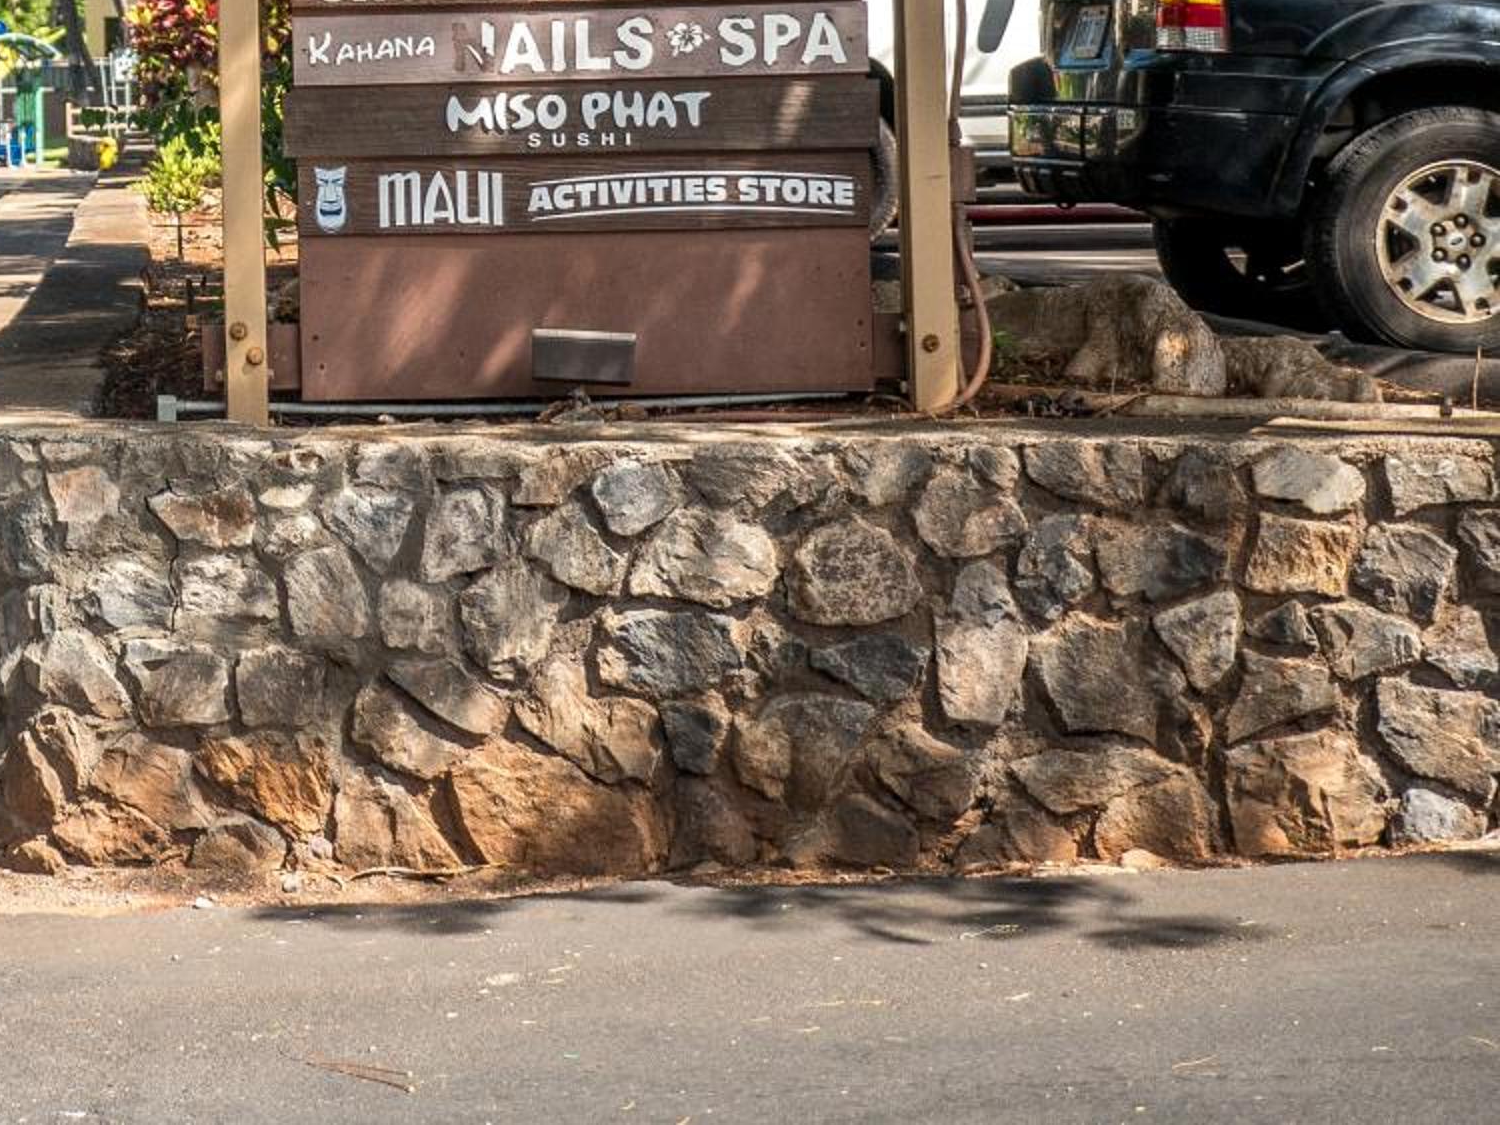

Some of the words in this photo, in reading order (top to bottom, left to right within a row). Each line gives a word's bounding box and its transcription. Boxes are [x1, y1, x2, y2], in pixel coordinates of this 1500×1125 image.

[717, 12, 848, 66] SPA
[446, 92, 568, 132] MISO
[581, 91, 712, 130] PHAT
[527, 132, 632, 147] SUSHI
[379, 170, 503, 228] MAUI
[527, 177, 727, 212] ACTIVITIES
[737, 177, 854, 207] STORE
